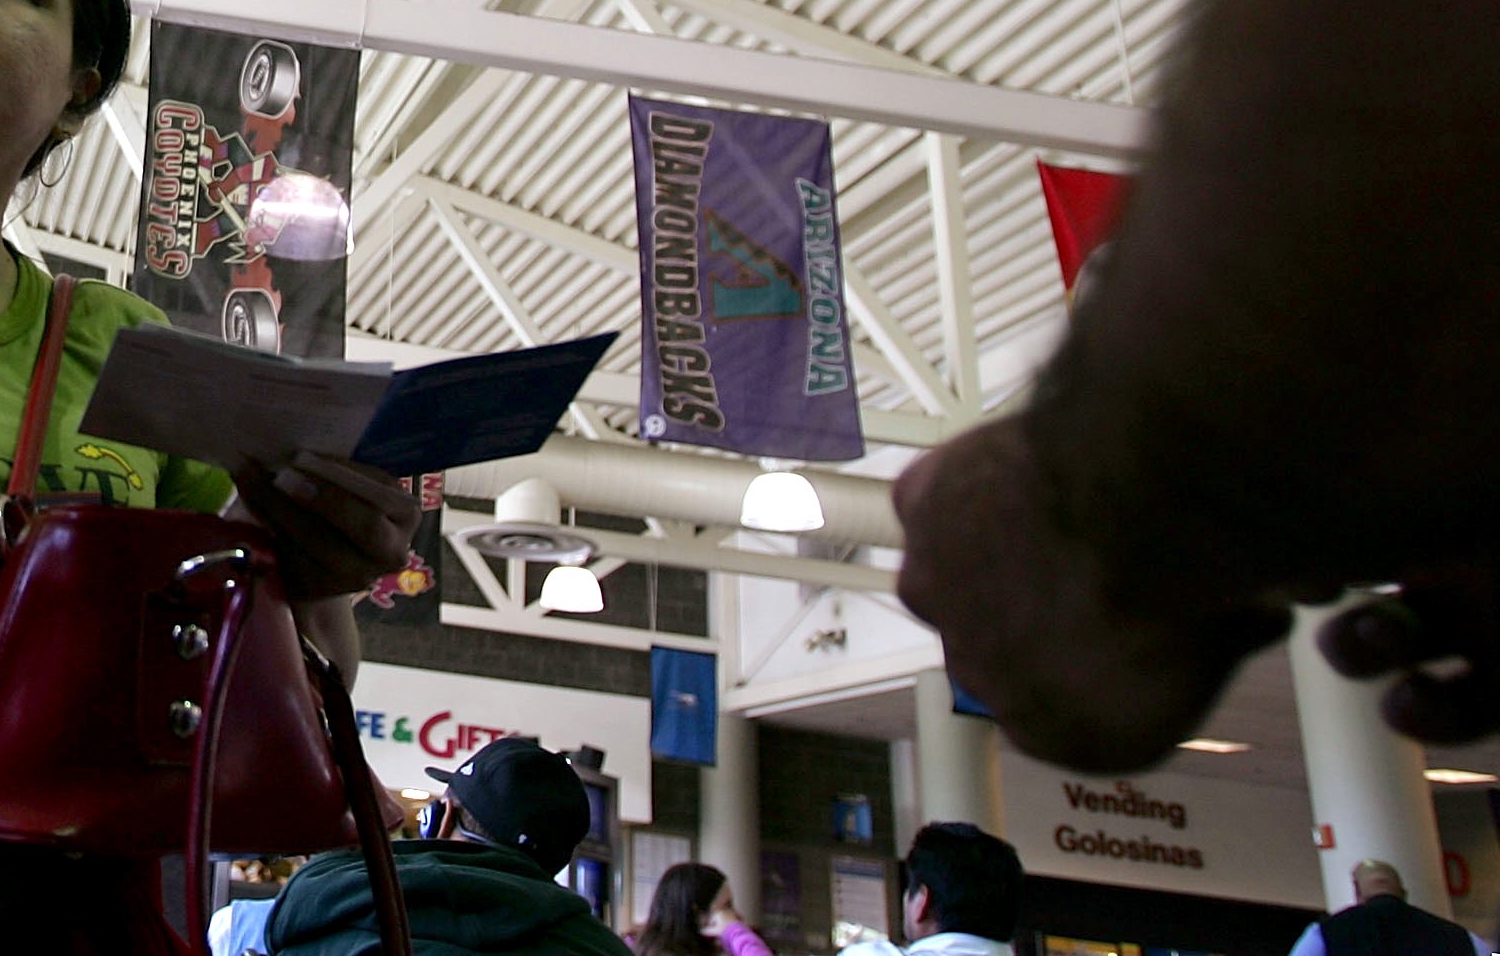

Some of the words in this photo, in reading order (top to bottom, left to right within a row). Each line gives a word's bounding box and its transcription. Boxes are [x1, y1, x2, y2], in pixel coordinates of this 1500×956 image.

[148, 101, 203, 278] COYOTES
[175, 132, 200, 249] PHOENIX
[648, 111, 725, 432] DIAMONDBACKS
[794, 177, 849, 395] ARIZONA
[419, 711, 520, 758] GIFT
[1054, 825, 1204, 869] Golosinas
[1063, 781, 1186, 828] Vending
